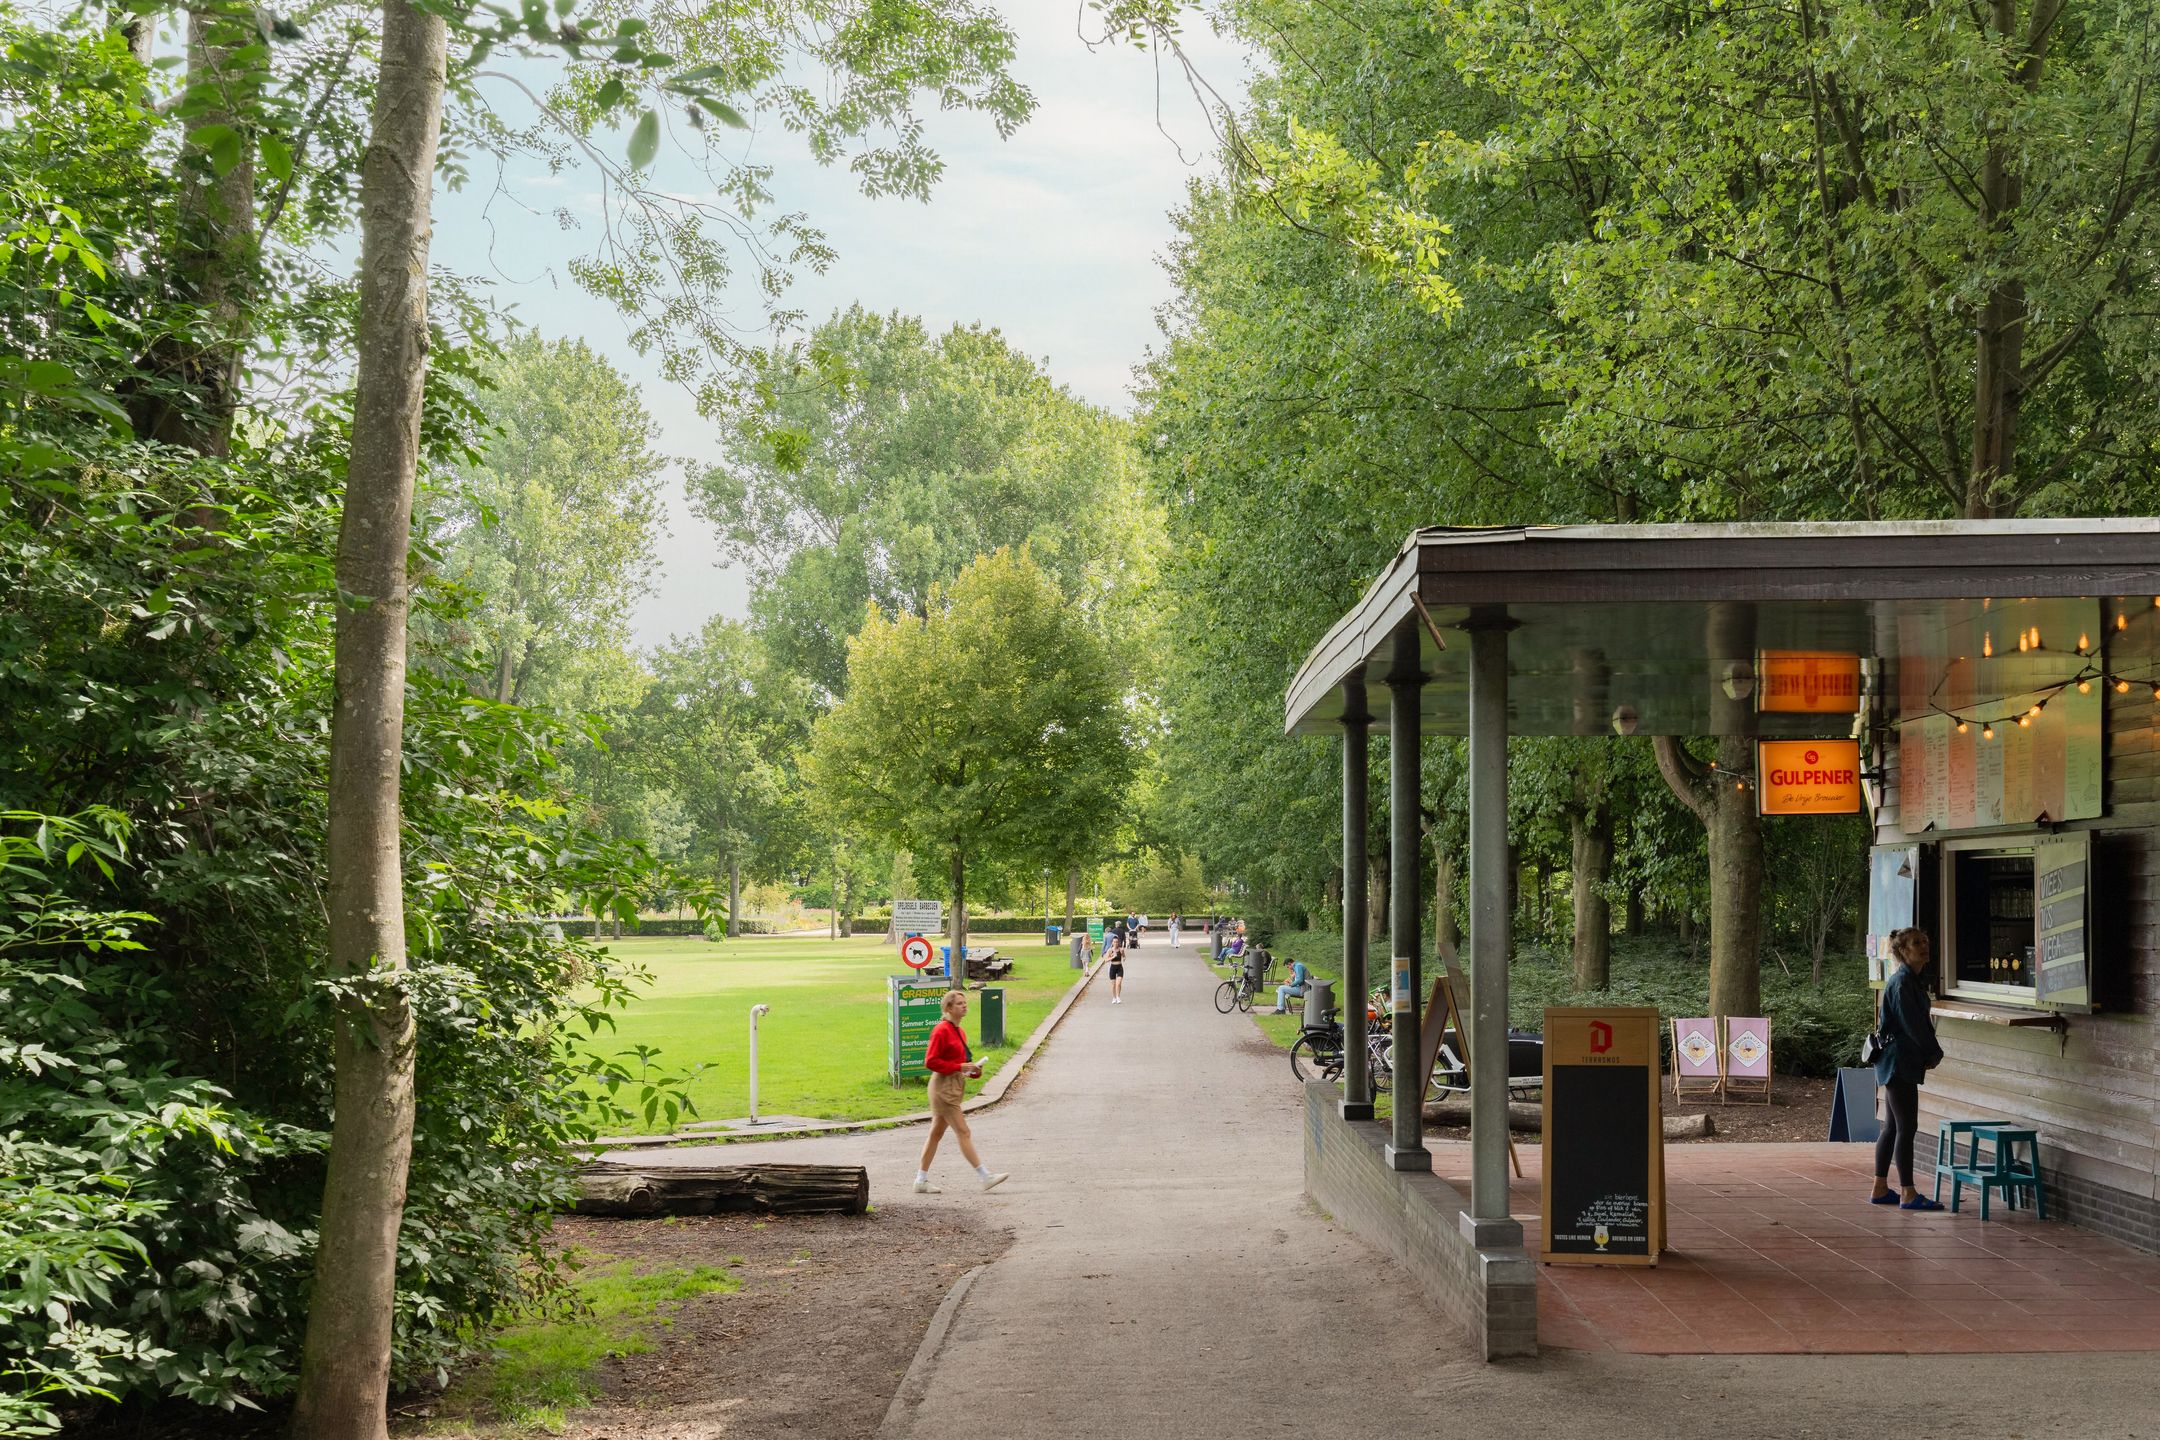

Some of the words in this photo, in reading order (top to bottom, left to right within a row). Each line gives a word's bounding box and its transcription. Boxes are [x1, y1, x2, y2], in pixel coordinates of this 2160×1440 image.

[1770, 769, 1854, 786] GULPENER
[2040, 904, 2053, 930] VIS
[924, 996, 942, 1006] PAR
[902, 1020, 924, 1028] Summer
[925, 1018, 942, 1026] Sessio
[902, 1059, 924, 1067] Summer
